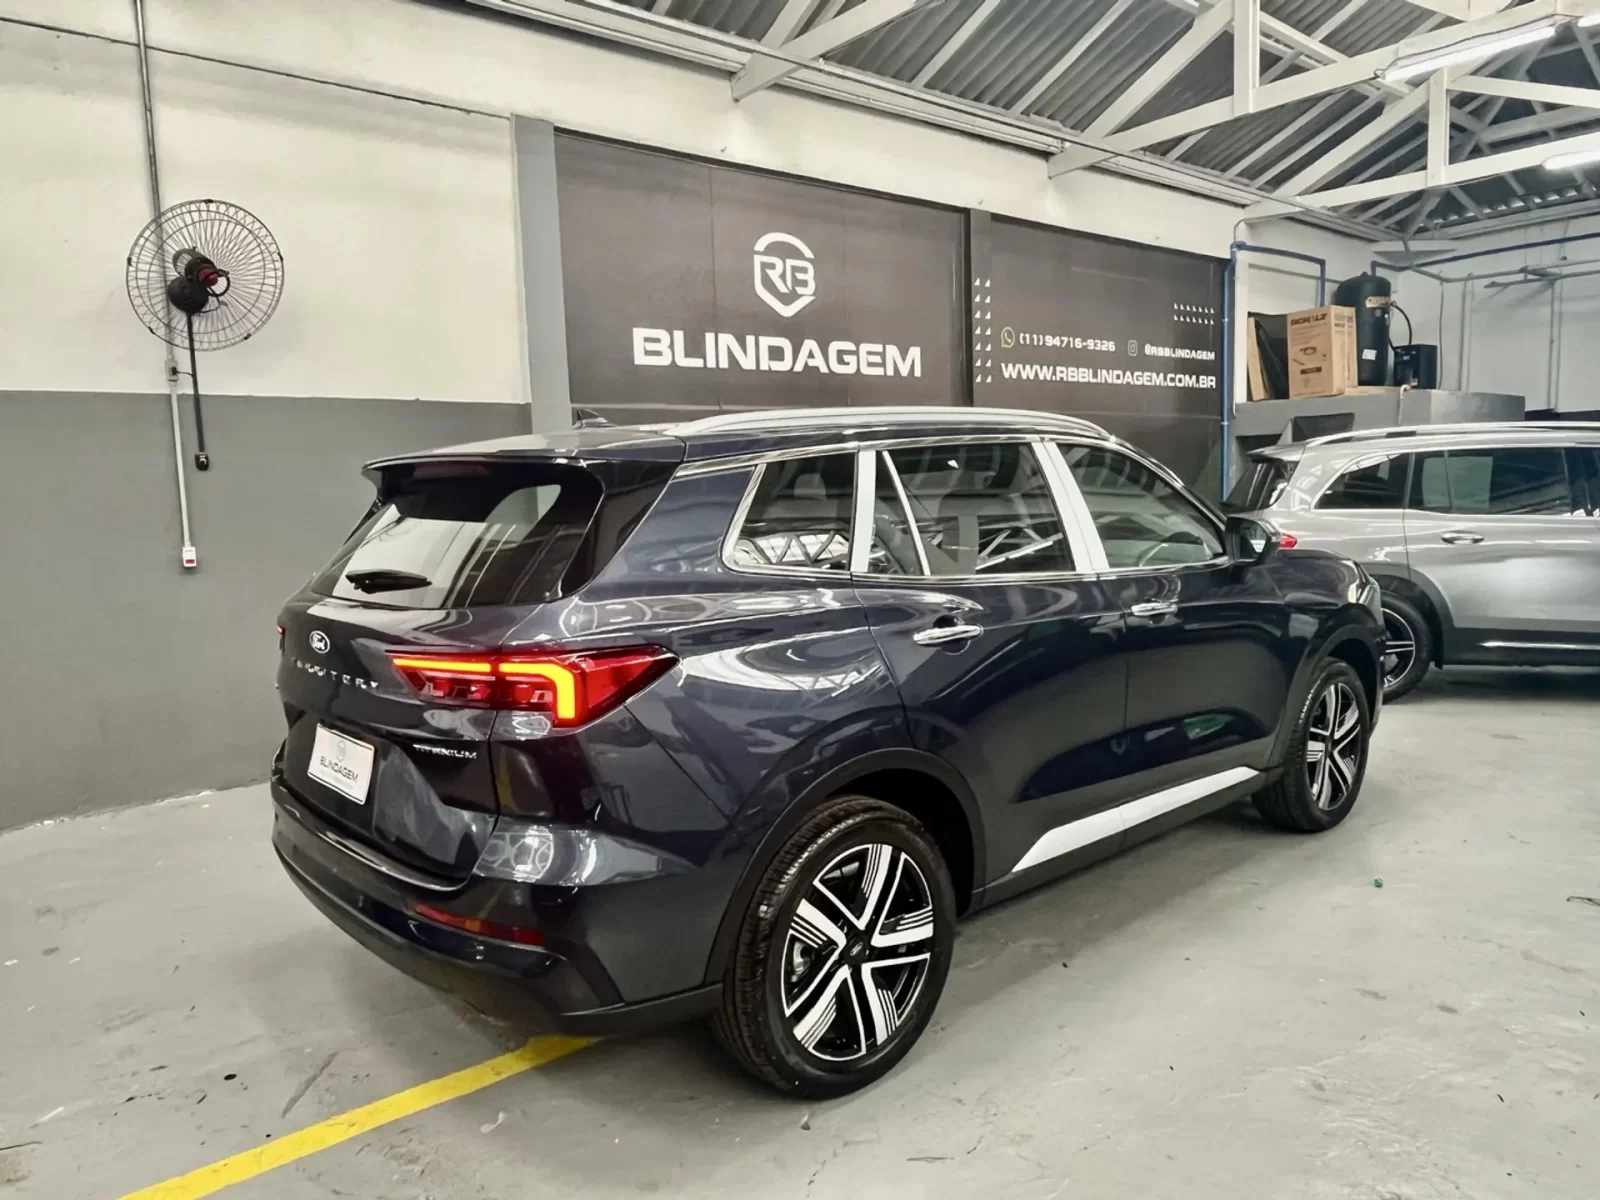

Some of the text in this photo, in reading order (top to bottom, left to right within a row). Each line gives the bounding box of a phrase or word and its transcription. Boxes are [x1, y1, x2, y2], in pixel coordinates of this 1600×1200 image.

[632, 327, 922, 378] BLINDAGEM
[1019, 333, 1116, 352] (11)94716-9326
[1144, 343, 1215, 361] @RBBLINDAGEM
[1001, 363, 1216, 388] WWW.RBBLINDAGEM.COM.BR
[412, 744, 477, 759] TITANIUM
[319, 755, 359, 783] BLINDAGEM
